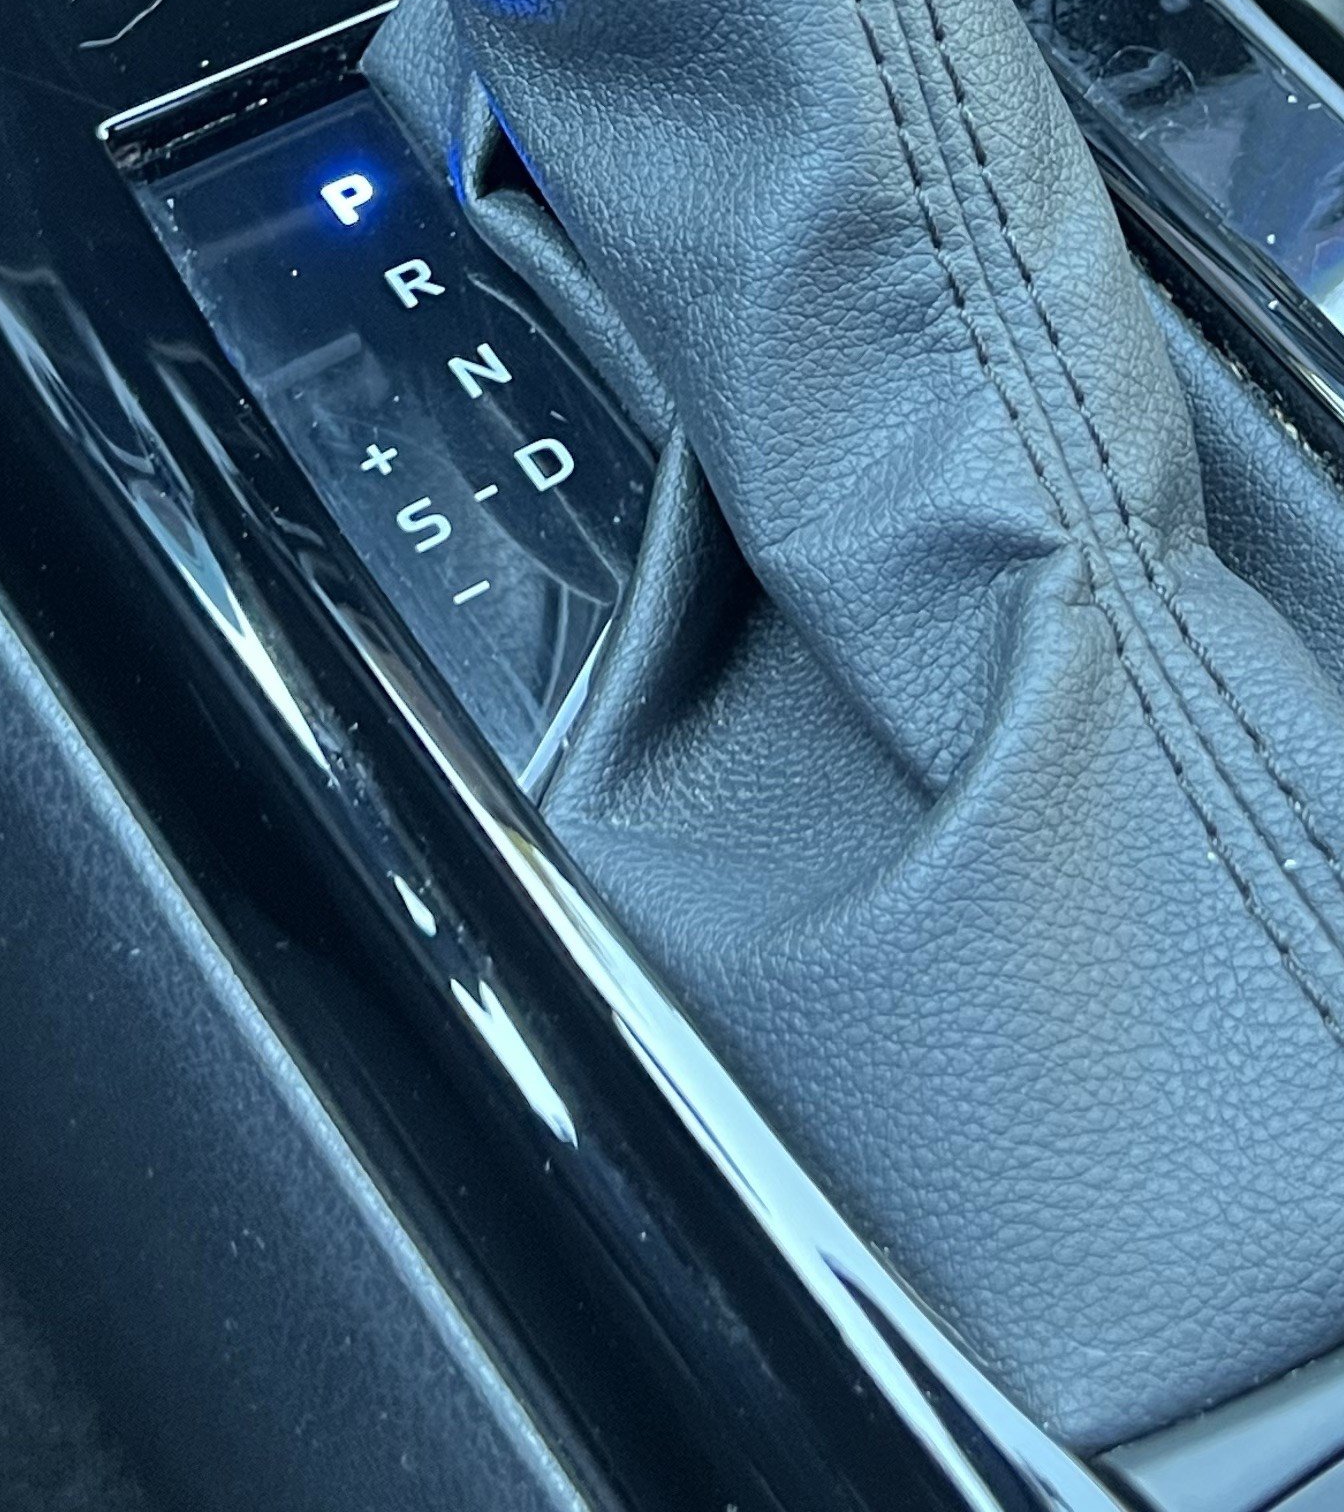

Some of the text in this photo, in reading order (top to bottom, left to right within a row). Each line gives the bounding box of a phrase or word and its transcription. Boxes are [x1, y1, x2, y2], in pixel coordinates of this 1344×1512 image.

[320, 173, 374, 226] P
[384, 258, 446, 309] R
[448, 343, 512, 399] N
[513, 437, 576, 492] D
[396, 496, 453, 554] S
